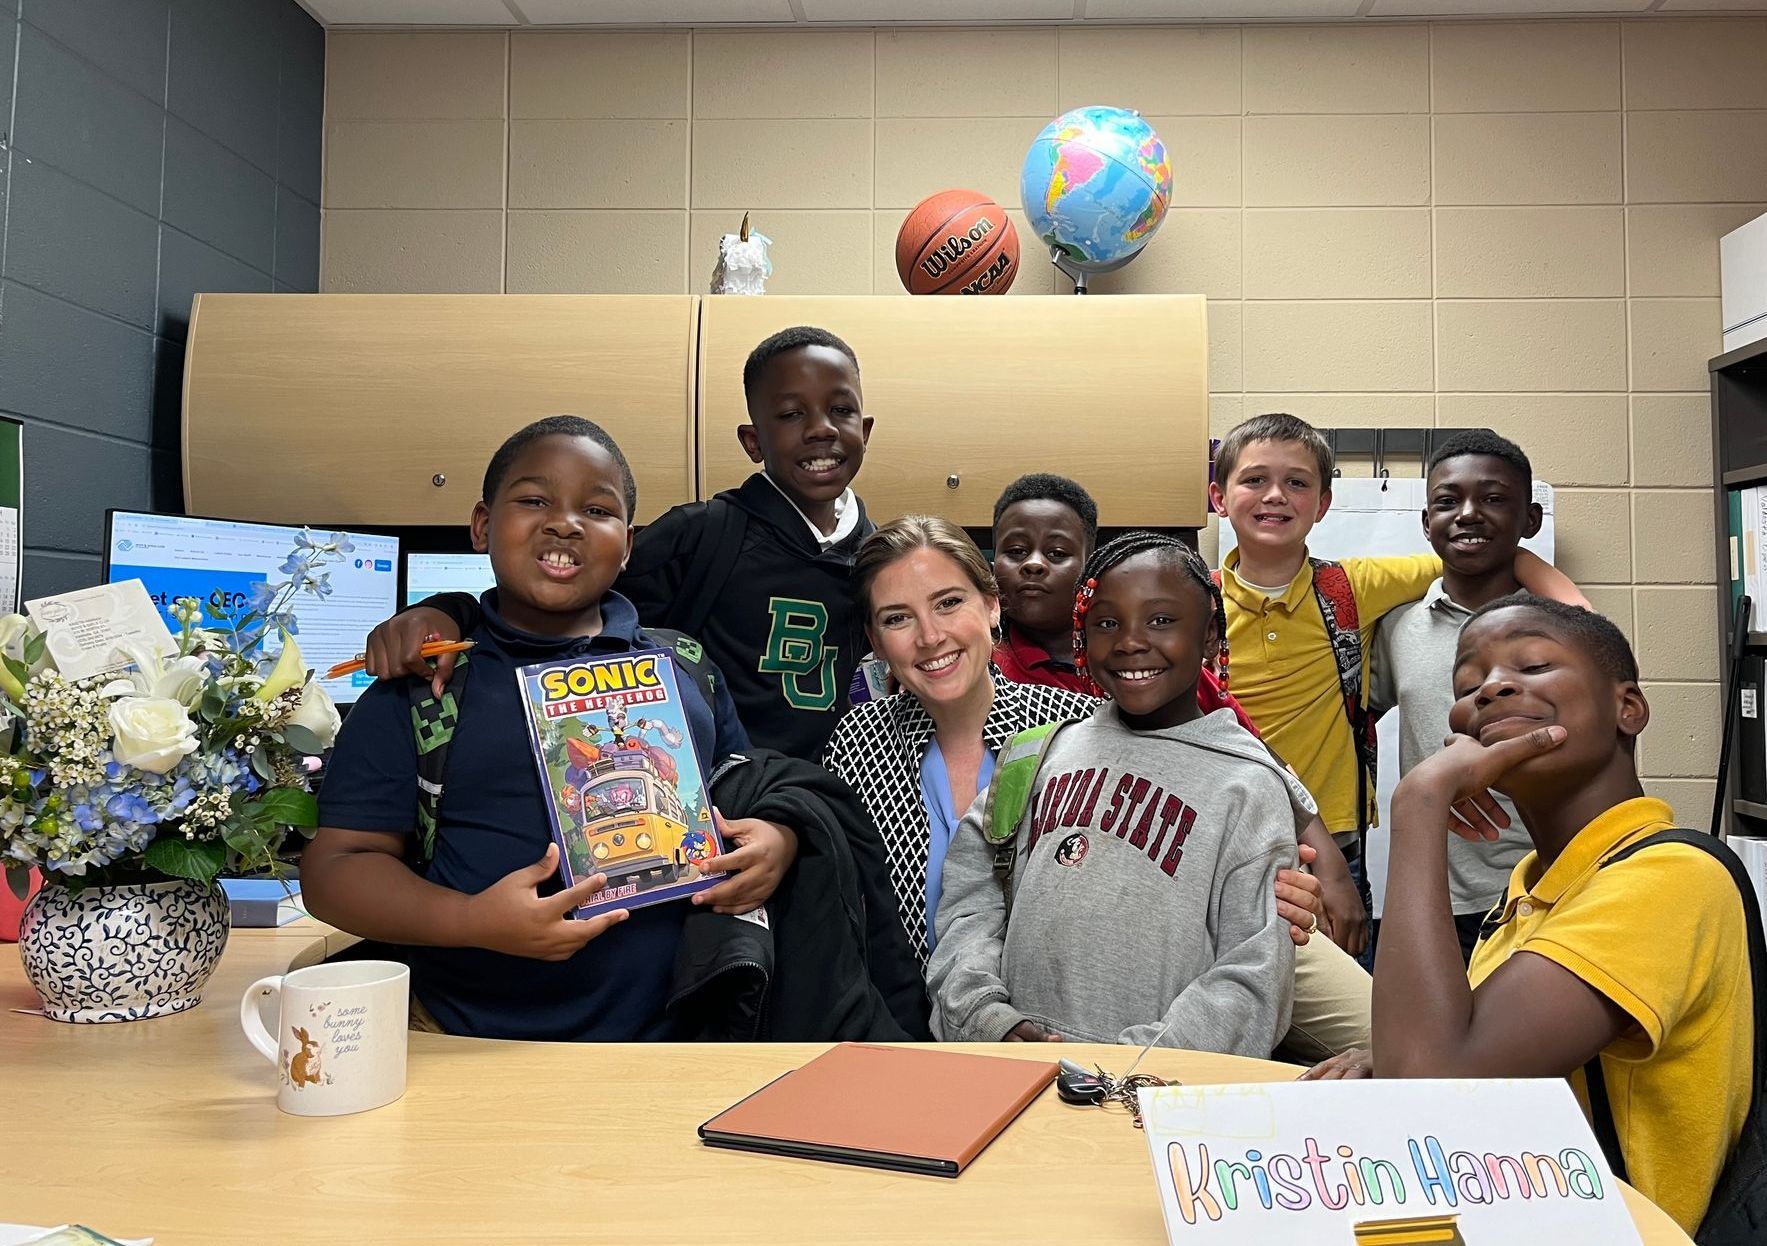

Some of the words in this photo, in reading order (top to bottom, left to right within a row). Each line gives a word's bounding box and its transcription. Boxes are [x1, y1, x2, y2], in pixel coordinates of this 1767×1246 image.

[920, 218, 994, 278] Wilson
[960, 251, 1011, 295] NCAA
[541, 657, 661, 701] SONIC
[547, 703, 578, 717] THE
[1029, 768, 1109, 850] ORIDA
[1100, 772, 1198, 878] STATE
[581, 890, 605, 905] RIAL
[605, 887, 617, 900] BY
[618, 883, 636, 897] FIRE
[323, 1014, 365, 1031] bunny
[337, 1006, 368, 1017] some
[332, 1029, 362, 1043] loves
[333, 1045, 360, 1059] you
[1167, 1137, 1407, 1225] Kristin
[1408, 1135, 1605, 1208] Hanna
